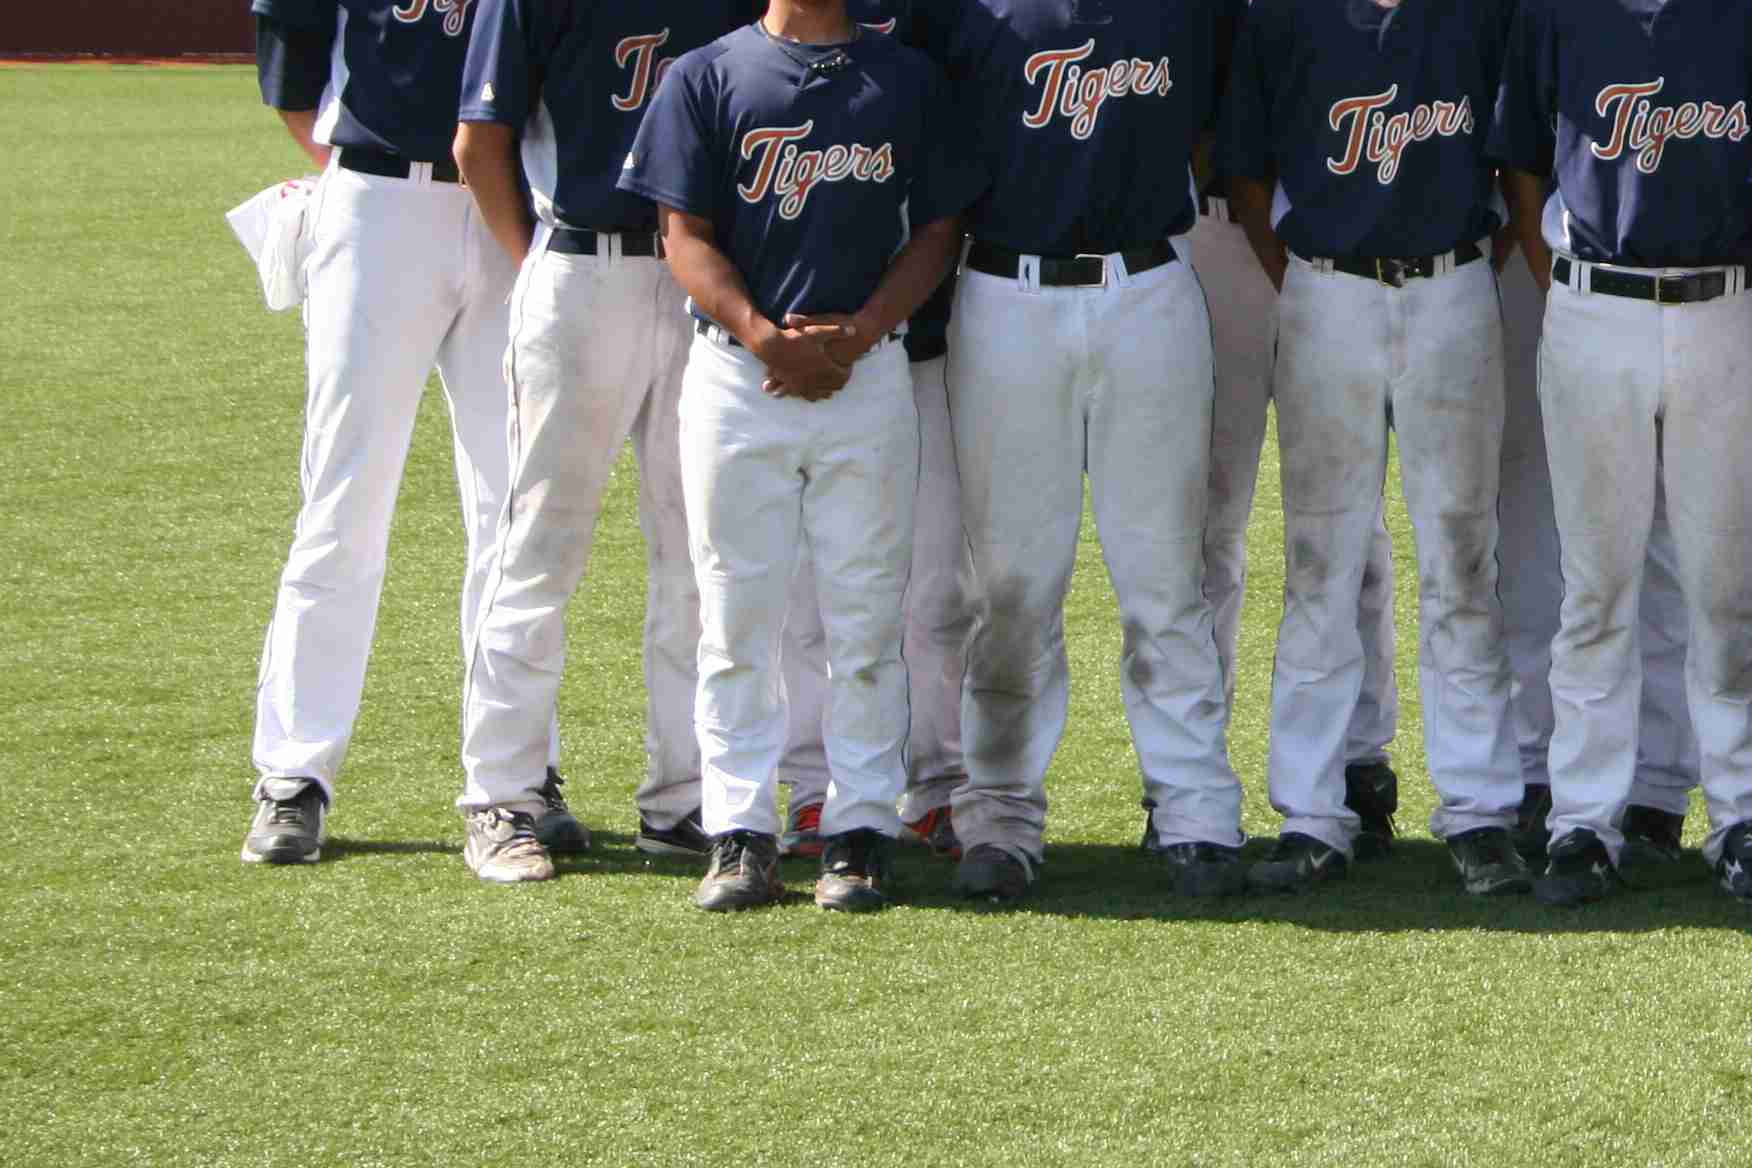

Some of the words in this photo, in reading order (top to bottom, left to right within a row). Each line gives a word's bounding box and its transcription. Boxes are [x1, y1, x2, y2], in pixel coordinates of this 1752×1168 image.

[1023, 38, 1173, 140] Tigers
[1326, 83, 1475, 185] Tigers
[1588, 76, 1750, 174] Tigers
[736, 118, 894, 220] Tigers
